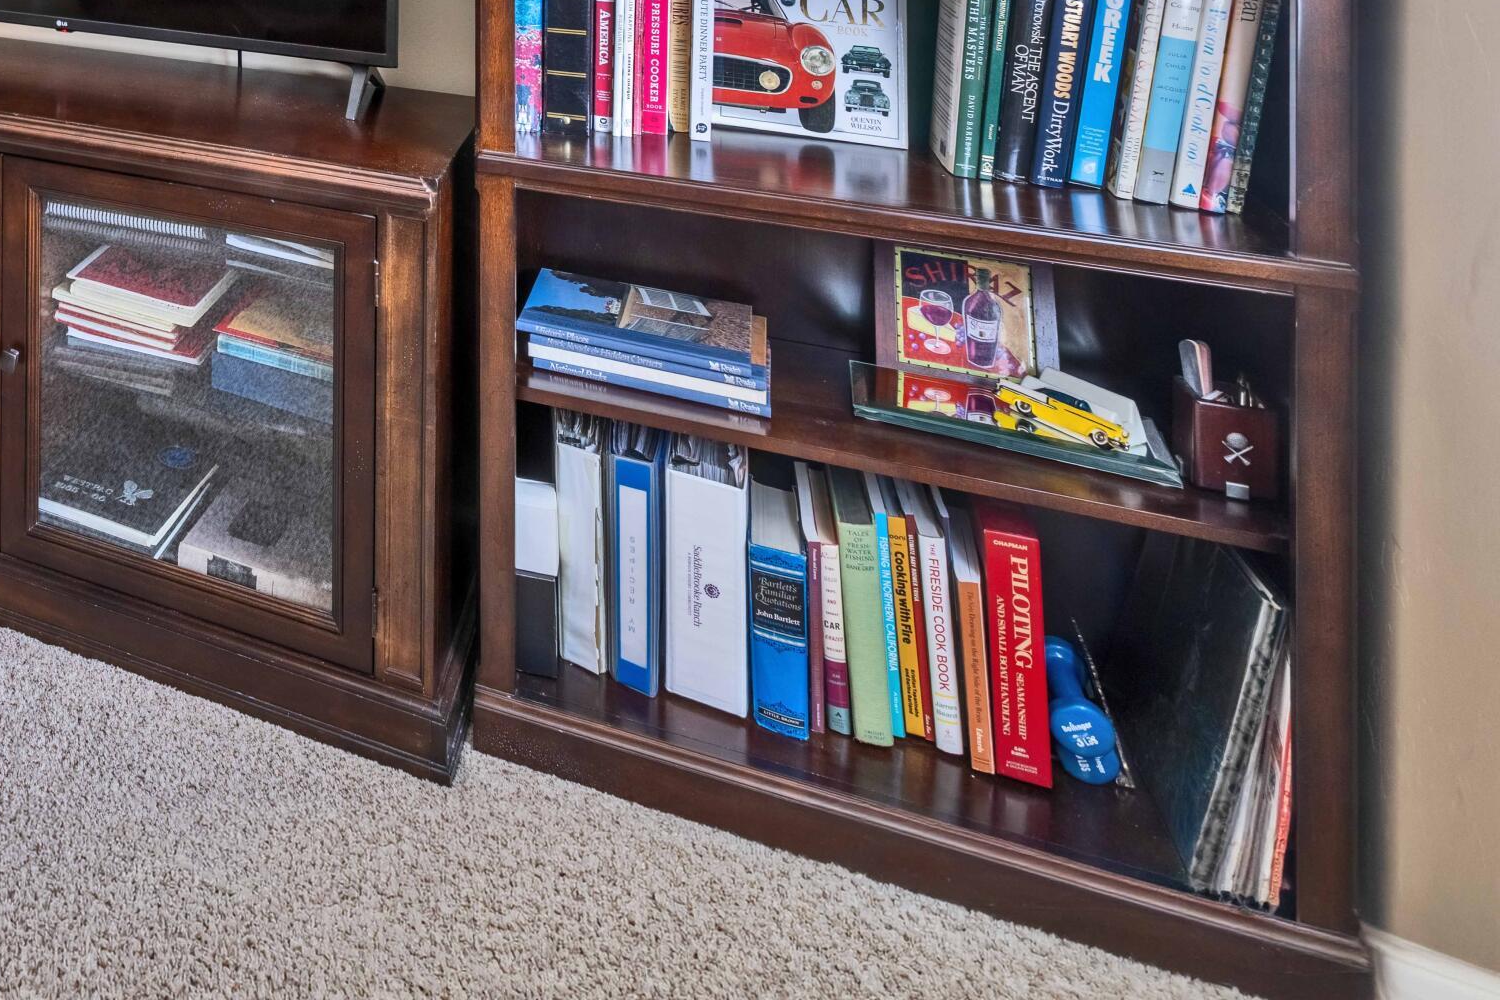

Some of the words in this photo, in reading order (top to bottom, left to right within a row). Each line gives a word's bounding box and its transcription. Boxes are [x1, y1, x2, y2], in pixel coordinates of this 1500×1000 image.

[968, 0, 980, 23] THE
[599, 9, 610, 66] AMERICA
[650, 3, 660, 55] PRESSURE
[699, 19, 708, 53] DINNER
[836, 25, 868, 37] BOOK
[995, 21, 1005, 51] ESSENTIALS
[965, 27, 978, 80] MASTERS
[977, 56, 983, 66] OF
[1014, 45, 1028, 61] OF
[1027, 47, 1043, 72] THE
[1137, 59, 1148, 71] &
[1165, 62, 1187, 70] CHILD
[649, 58, 660, 103] COOKER
[698, 54, 707, 82] PARTY
[1011, 62, 1027, 94] MAN
[1053, 51, 1077, 100] WOODS
[1020, 73, 1039, 123] ASCENT
[1156, 84, 1188, 93] JACQUES
[966, 95, 975, 119] DAVID
[1128, 75, 1146, 133] SALSAS
[850, 116, 882, 125] QUENTIN
[850, 123, 882, 132] WILLSON
[1046, 101, 1070, 140] Dirty
[1042, 138, 1062, 173] Work
[1037, 174, 1063, 183] PUTNAM
[905, 259, 1022, 307] SHIRAZ
[549, 361, 584, 375] National
[631, 354, 663, 369] Corners
[879, 536, 890, 567] FISHING
[993, 539, 1028, 551] CHAPMAN
[692, 545, 703, 600] SaddleBrooke
[758, 576, 797, 593] Bartlett's
[881, 570, 891, 578] IN
[893, 551, 909, 597] Cooking
[928, 557, 943, 613] FIRESIDE
[755, 592, 802, 611] Quotations
[758, 585, 796, 601] Familiar
[882, 580, 895, 622] NORTHERN
[996, 595, 1006, 618] AND
[692, 601, 702, 628] Ranch
[756, 608, 773, 620] John
[774, 613, 801, 626] Bartlett
[898, 599, 911, 622] with
[969, 613, 977, 635] Drawing
[1010, 554, 1033, 669] PILOTING
[823, 619, 840, 631] CAR
[900, 624, 913, 645] Fire
[932, 615, 947, 653] COOK
[998, 619, 1008, 653] SMALL
[885, 624, 898, 671] CALIFORNIA
[935, 651, 950, 692] BOOK
[971, 657, 980, 673] Right
[999, 655, 1009, 682] BOAT
[1000, 683, 1011, 736] HANDLING
[1015, 672, 1027, 740] SEAMANSHIP
